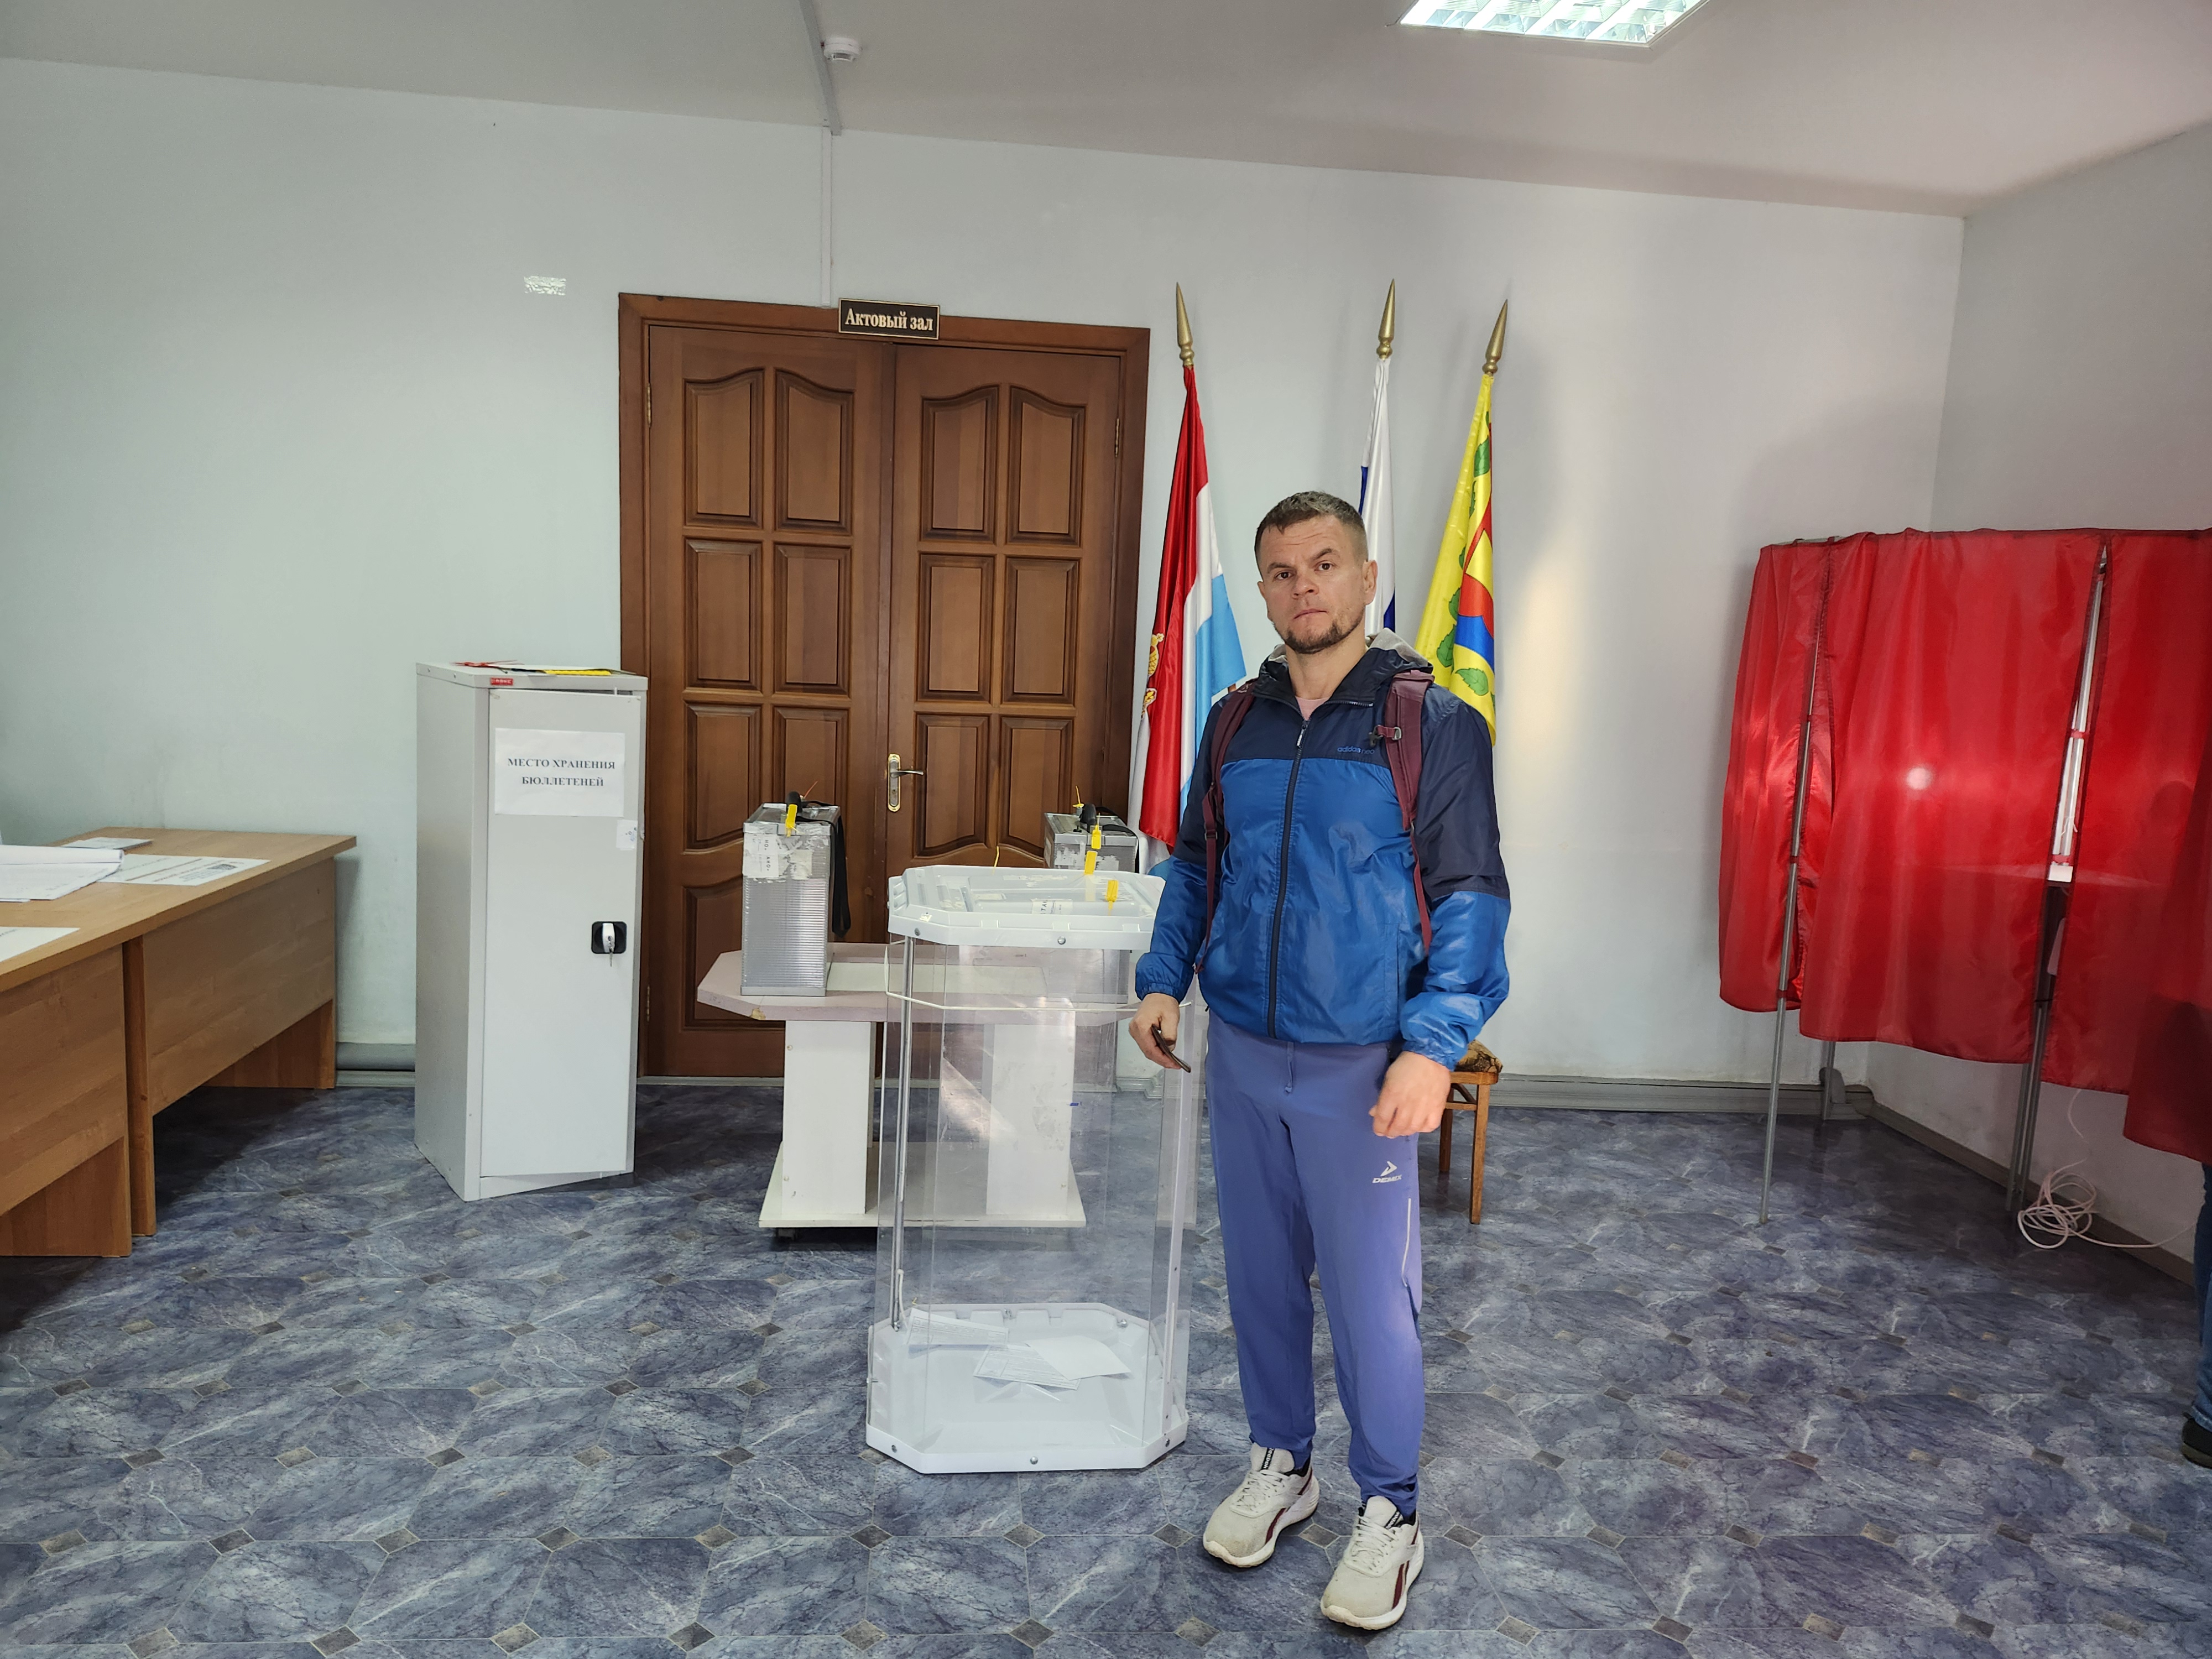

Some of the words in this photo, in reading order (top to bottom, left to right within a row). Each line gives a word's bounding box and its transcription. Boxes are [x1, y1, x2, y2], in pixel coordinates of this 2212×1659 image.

[844, 307, 907, 329] Актовый
[910, 317, 933, 331] зал
[508, 758, 550, 768] МЕСТО
[553, 759, 615, 769] ХРАНЕНИЯ
[522, 776, 604, 786] БЮЛЛЕТЕНЕЙ
[1372, 1174, 1402, 1183] DEMIX
